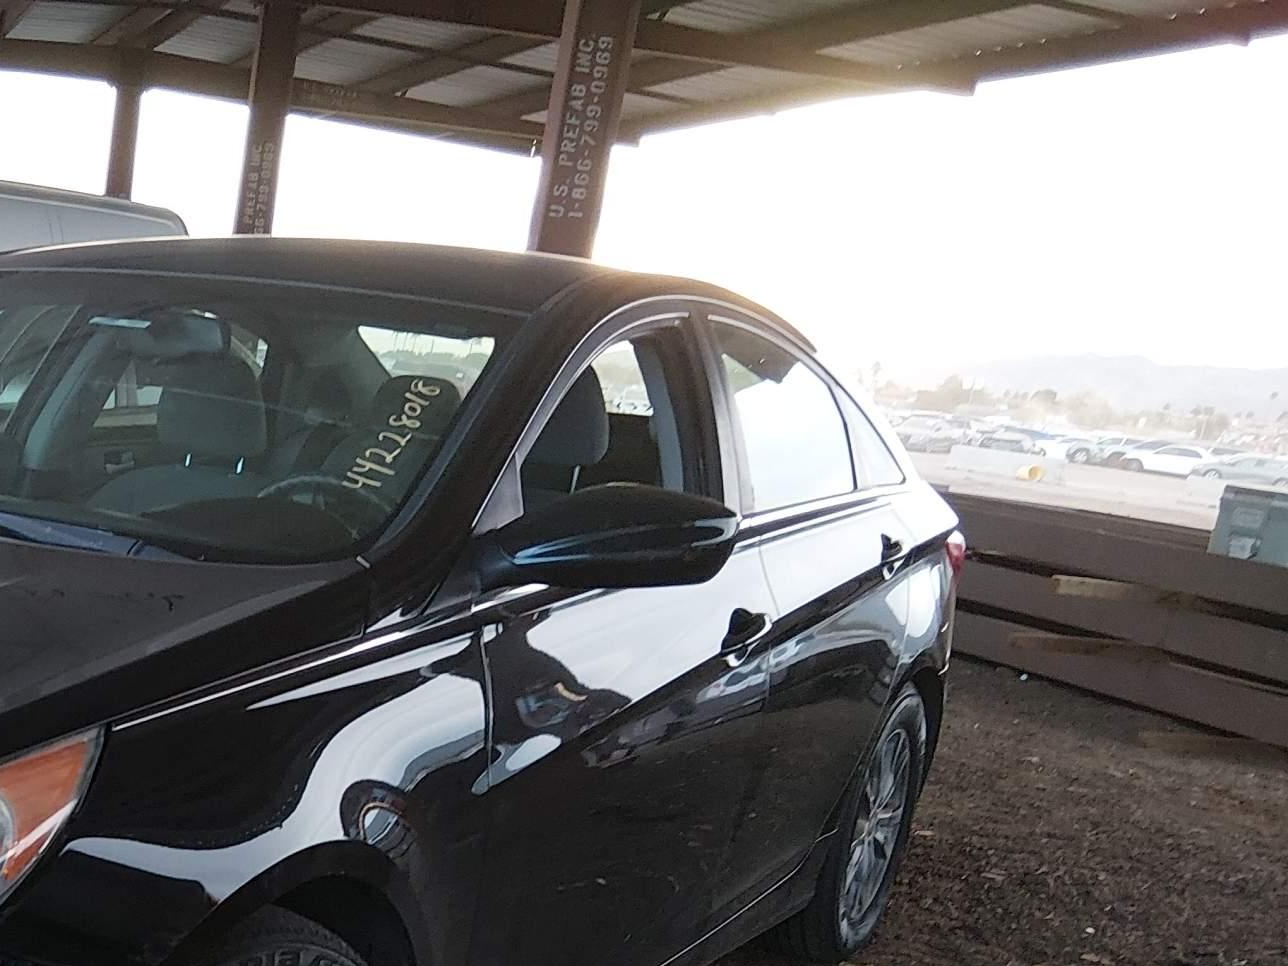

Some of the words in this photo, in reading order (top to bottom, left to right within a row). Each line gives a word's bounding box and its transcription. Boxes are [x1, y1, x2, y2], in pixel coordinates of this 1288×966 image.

[558, 83, 587, 166] PREFAB
[567, 35, 613, 219] 1-866-799-0969
[549, 179, 570, 218] U.S.
[342, 379, 440, 489] 44228018
